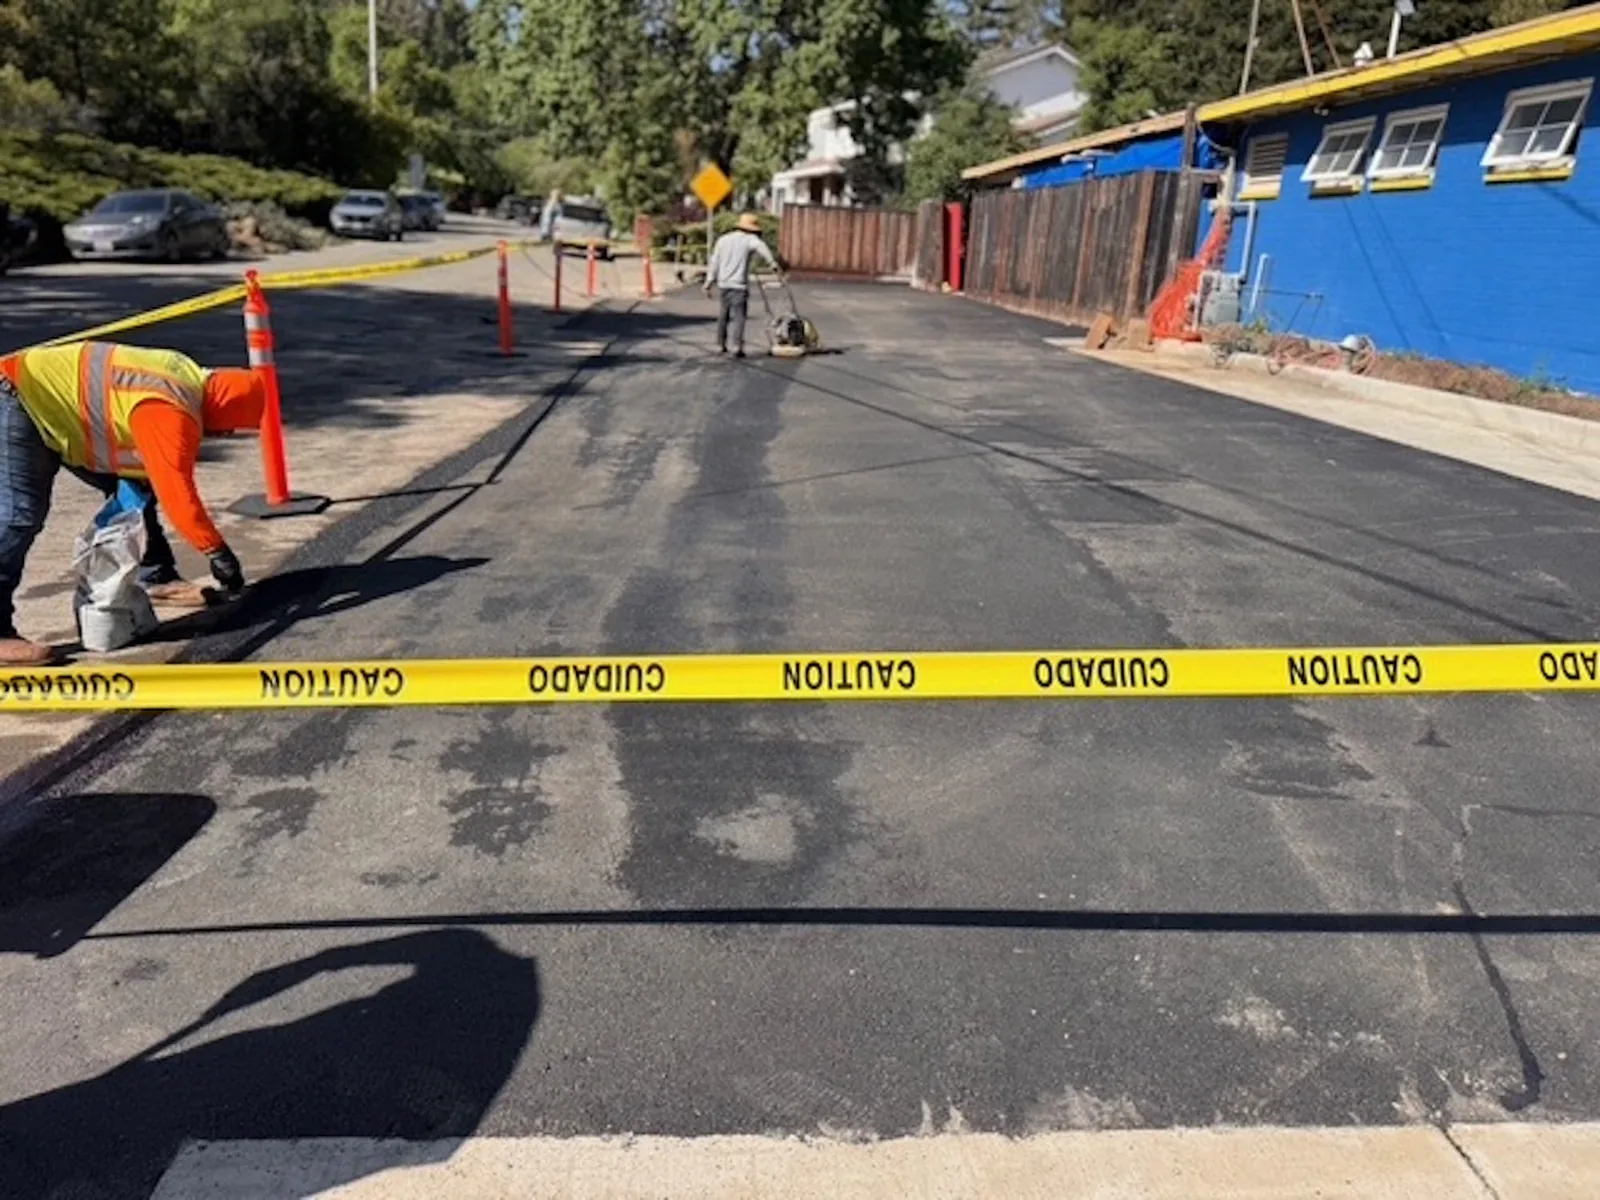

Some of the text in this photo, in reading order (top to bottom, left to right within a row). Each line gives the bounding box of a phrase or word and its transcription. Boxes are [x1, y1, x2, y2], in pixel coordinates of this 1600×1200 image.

[259, 668, 404, 698] CAUTION
[528, 663, 665, 693] CUIDADO
[783, 660, 916, 690] CAUTION
[1034, 657, 1168, 688] CUIDADO
[1287, 654, 1422, 686] CAUTION
